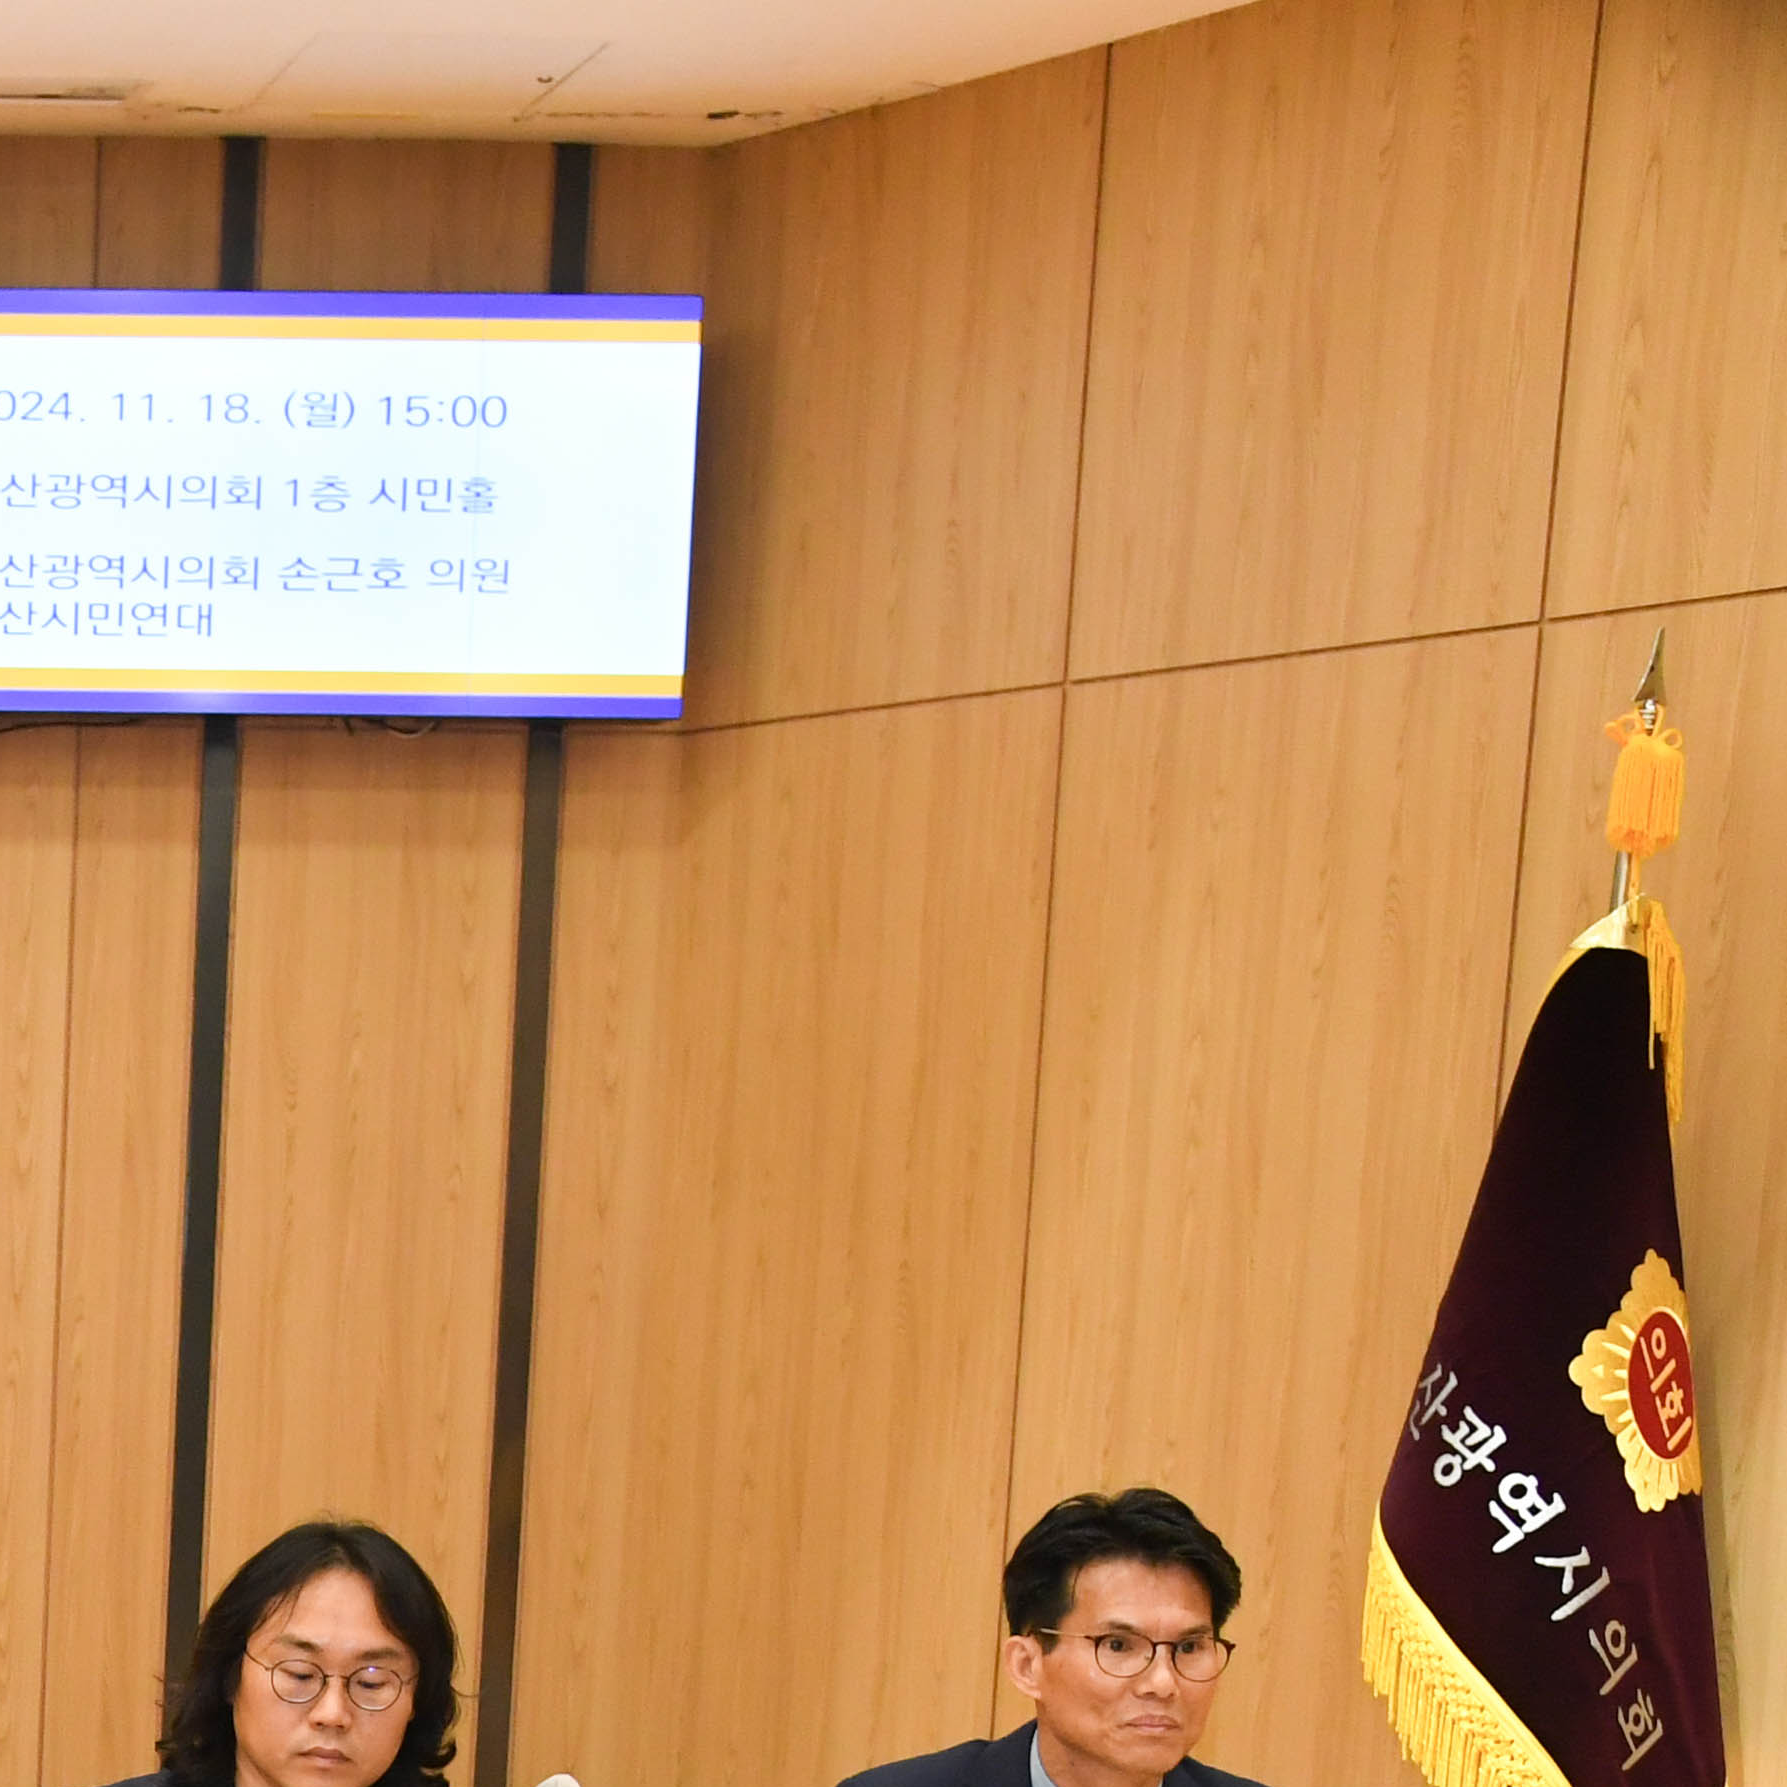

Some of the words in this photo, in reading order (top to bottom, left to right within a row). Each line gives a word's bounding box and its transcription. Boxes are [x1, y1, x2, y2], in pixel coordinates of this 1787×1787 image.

[114, 393, 173, 423] 11.
[202, 393, 260, 424] 18.
[284, 392, 355, 428] (월)
[380, 395, 507, 428] 15:00
[286, 476, 350, 512] 1층
[370, 477, 496, 513] 시민홀
[279, 557, 407, 592] 손근호
[430, 559, 509, 593] 의원
[1639, 1327, 1693, 1452] 의회
